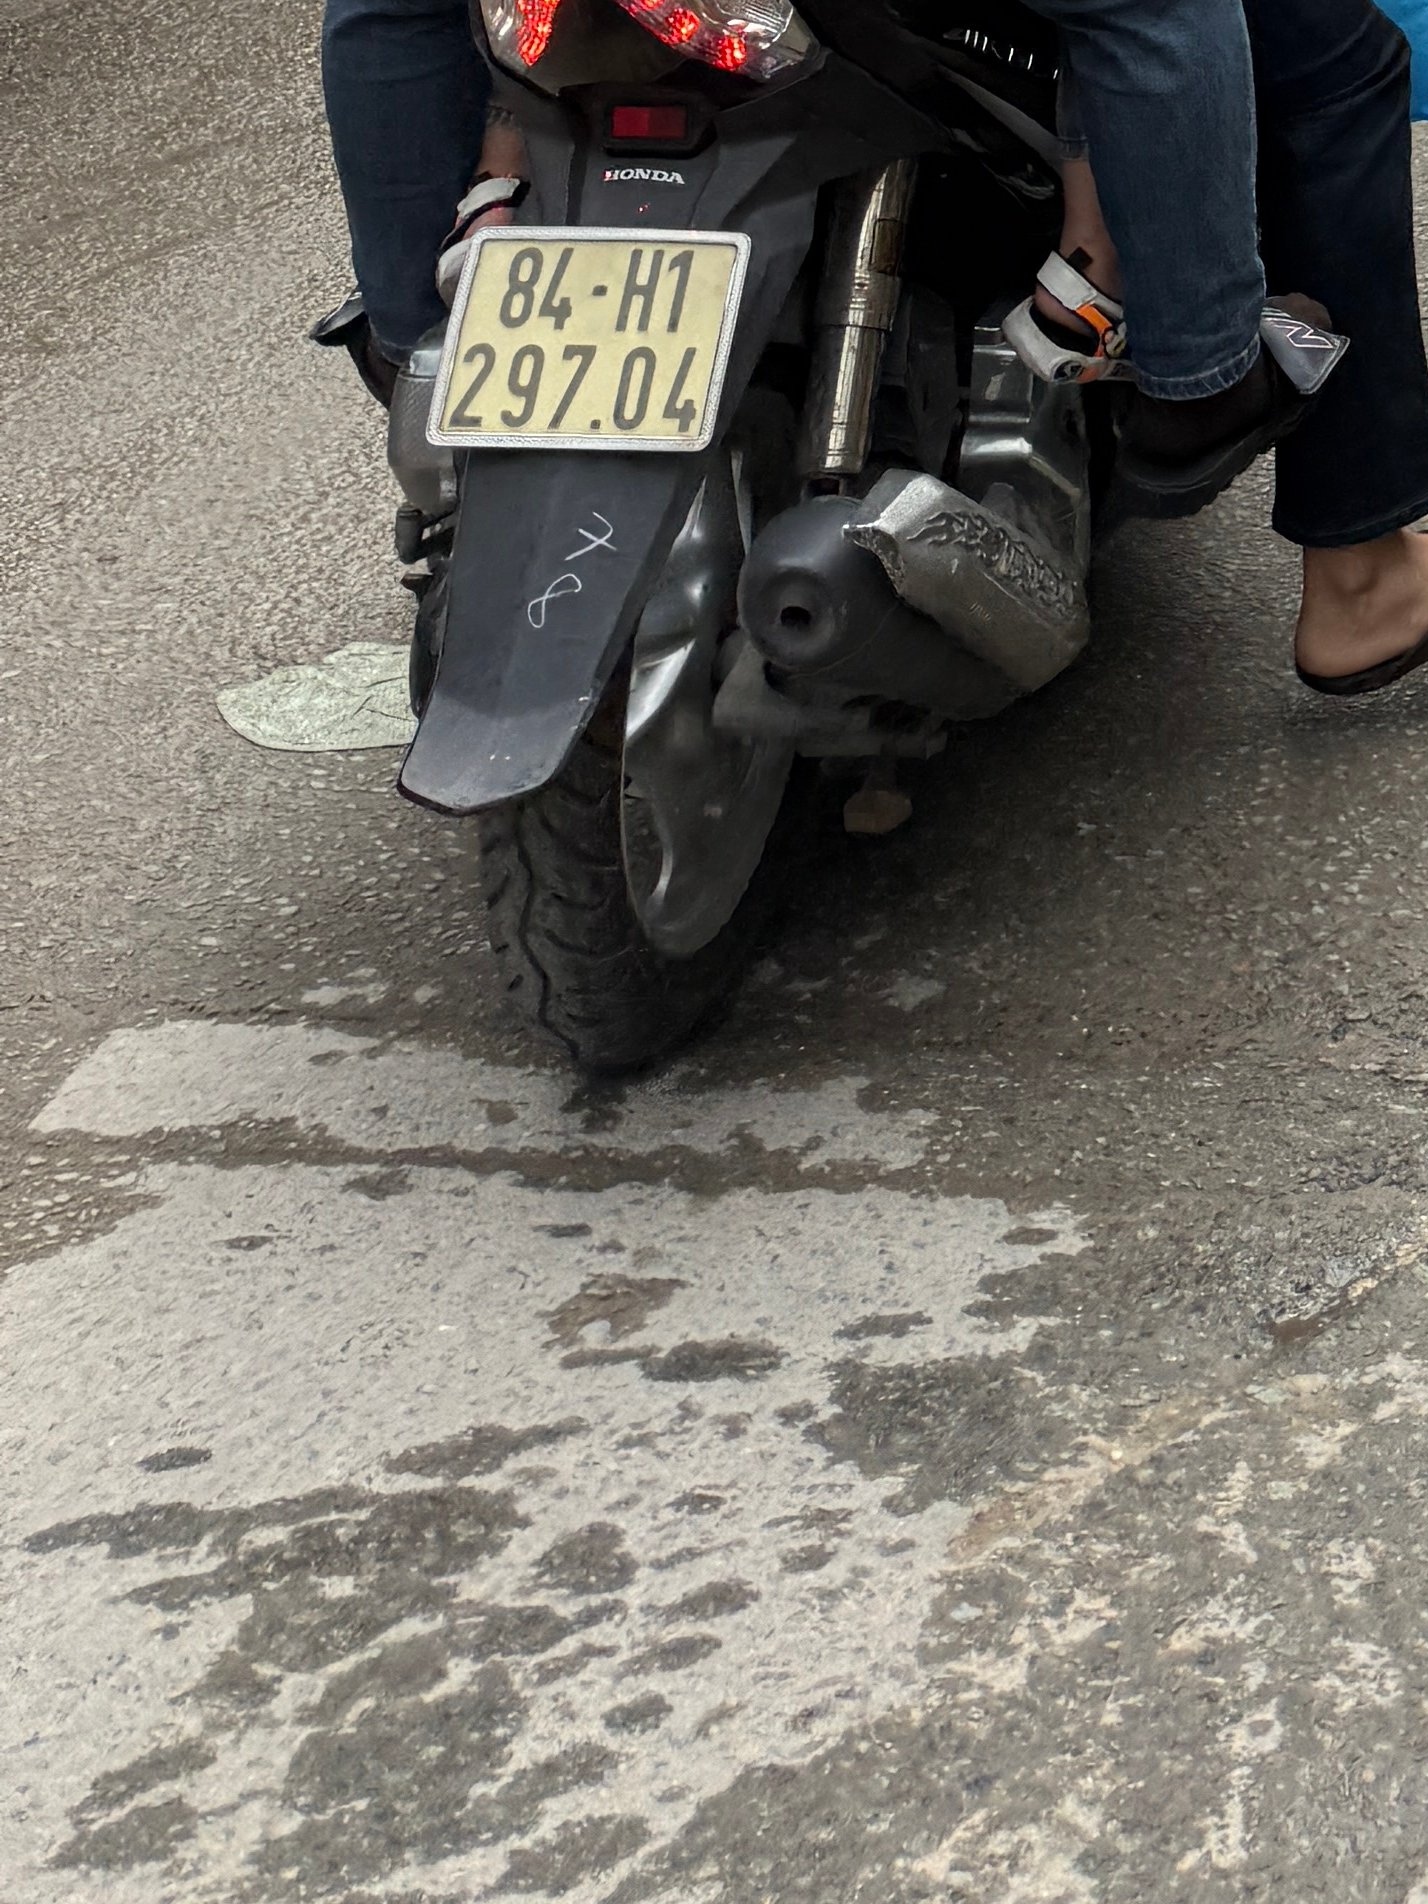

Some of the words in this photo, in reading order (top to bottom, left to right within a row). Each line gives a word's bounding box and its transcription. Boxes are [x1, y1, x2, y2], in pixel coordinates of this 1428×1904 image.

[604, 167, 686, 185] HONDA
[498, 247, 693, 334] 84-H1
[449, 342, 698, 434] 297.04
